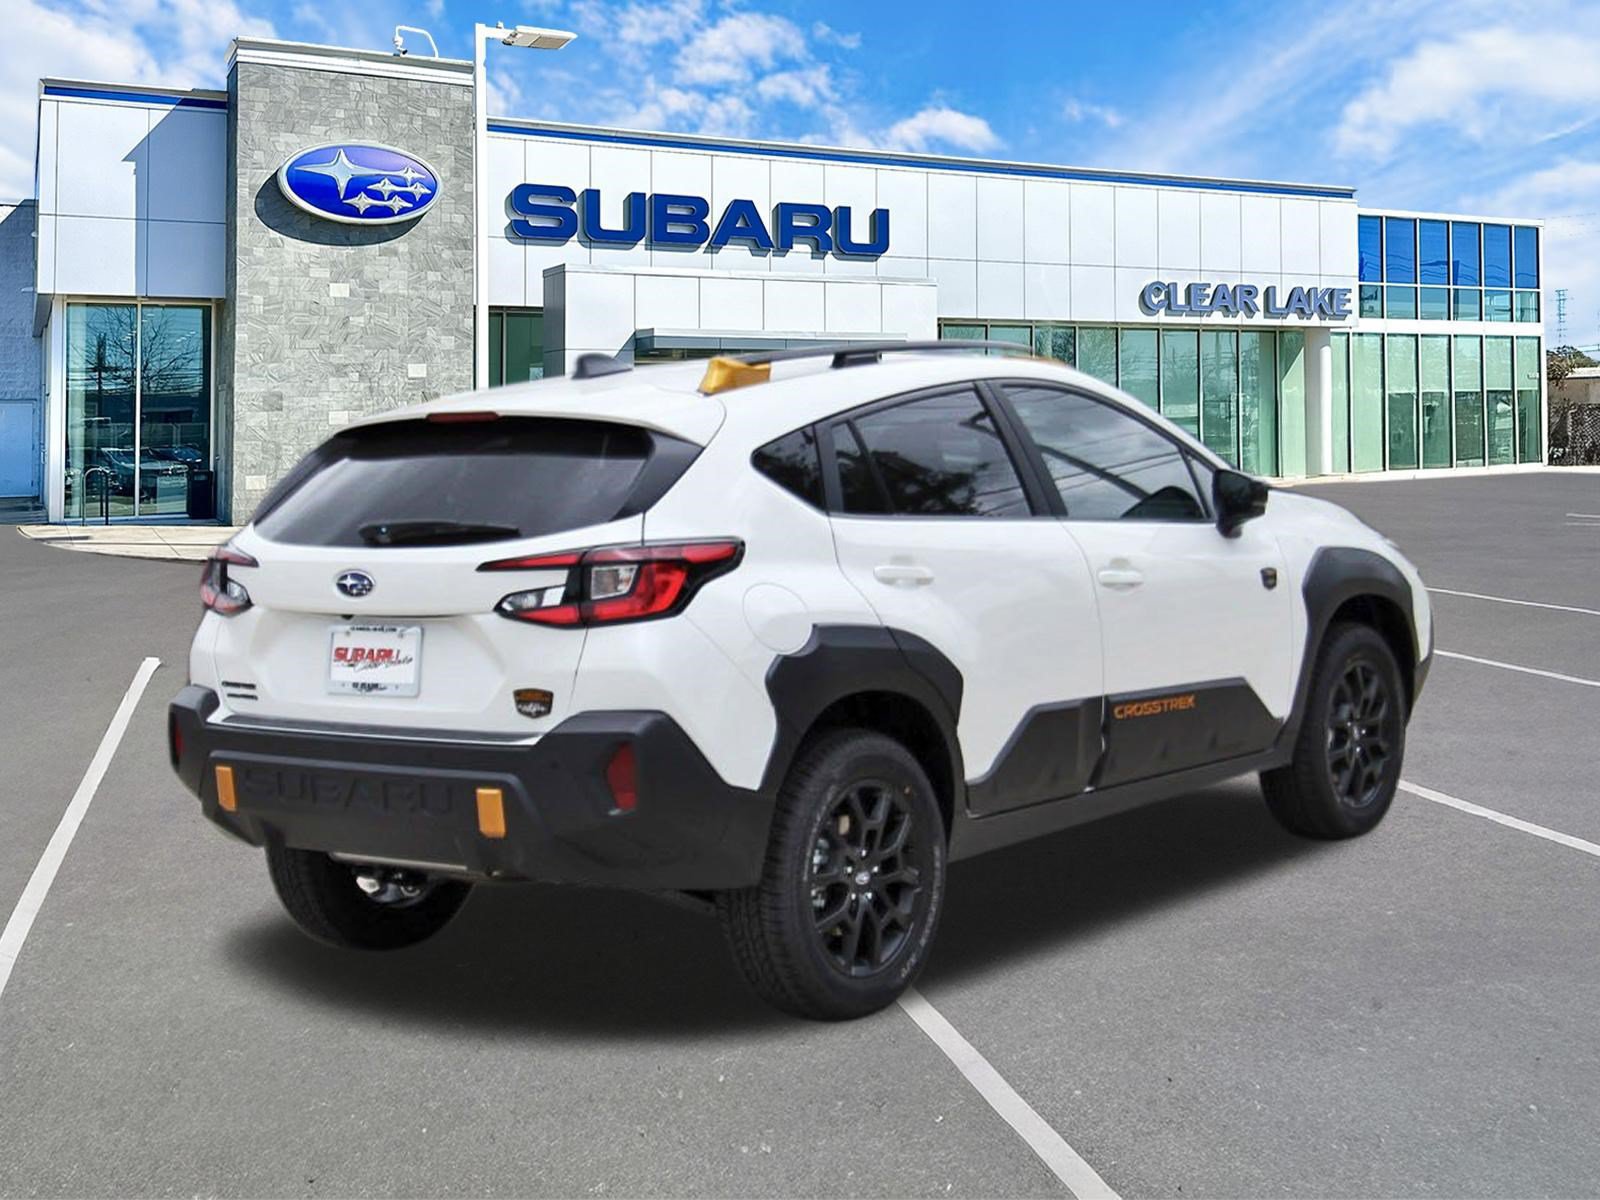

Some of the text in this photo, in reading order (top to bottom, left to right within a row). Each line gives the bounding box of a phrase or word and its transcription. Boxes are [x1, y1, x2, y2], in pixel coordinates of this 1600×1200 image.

[506, 183, 890, 259] SUBARU
[1140, 281, 1353, 319] CLEAR LAKE
[1113, 694, 1195, 719] CROSSTREK
[243, 769, 452, 819] SUBARU
